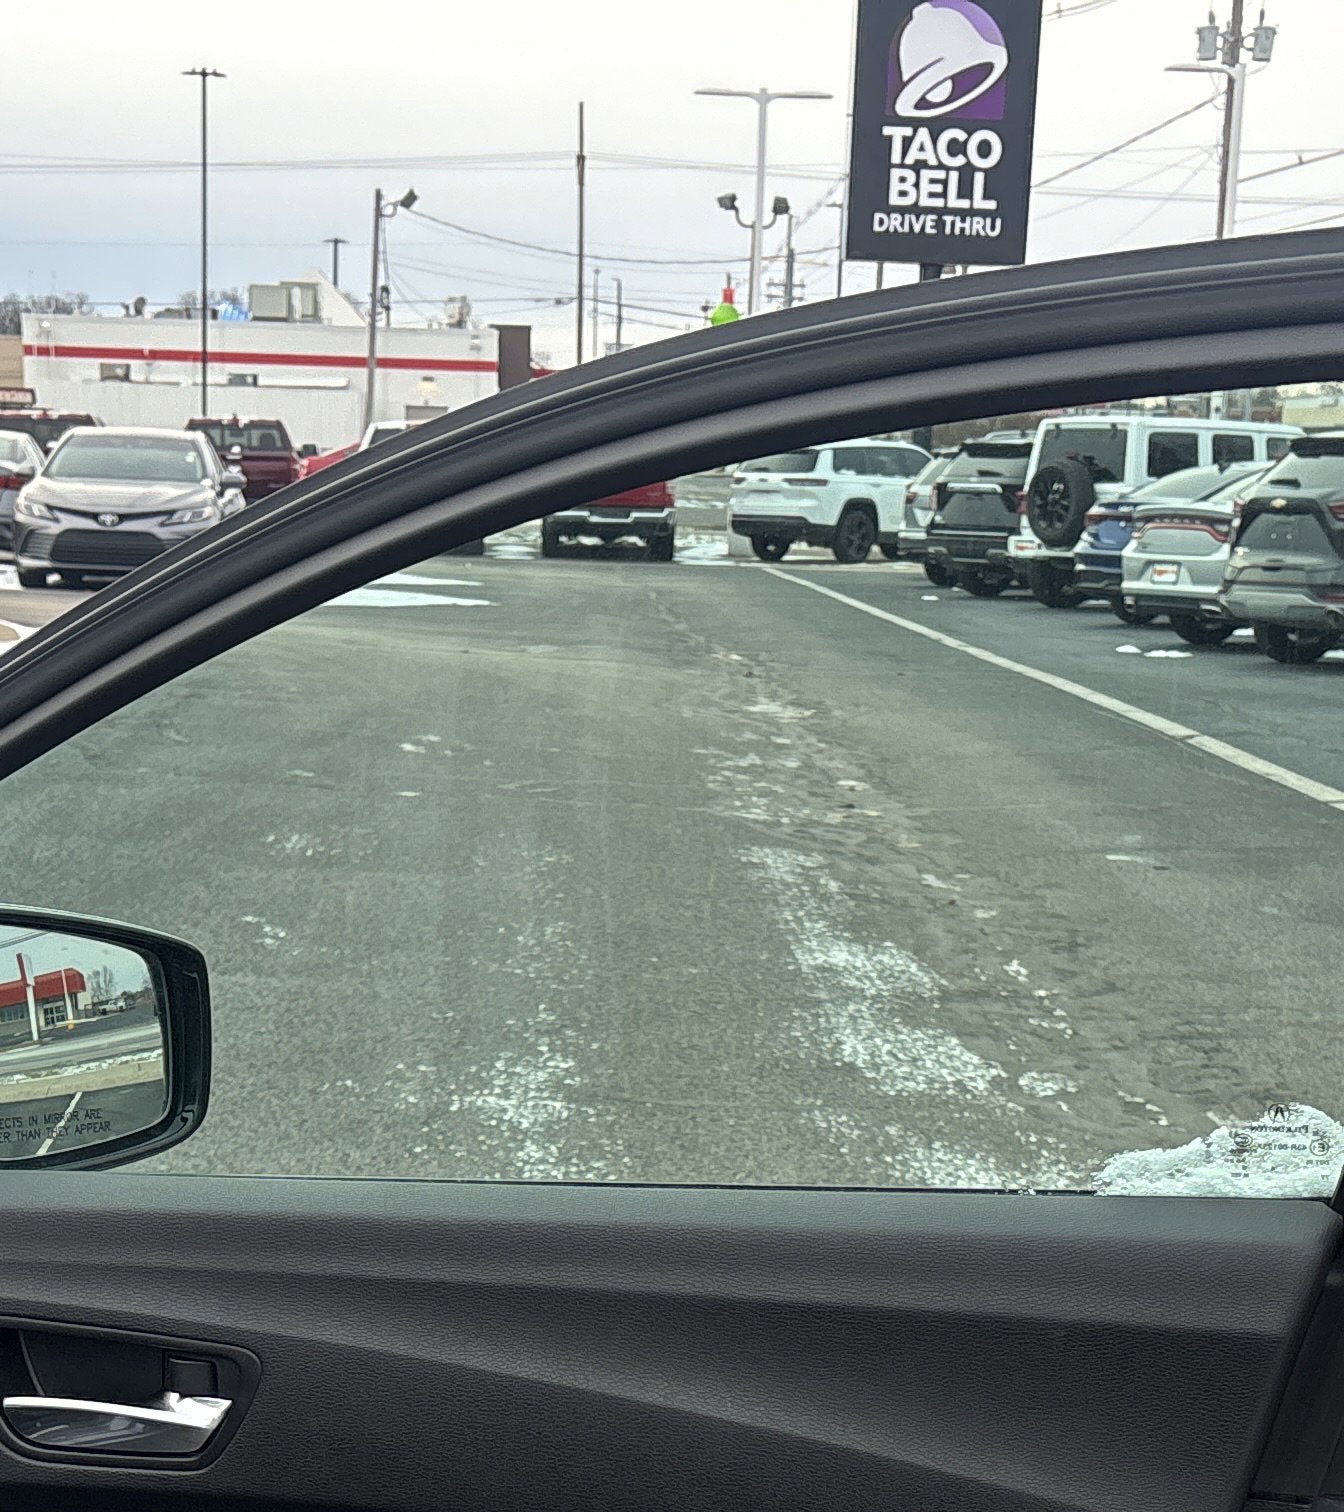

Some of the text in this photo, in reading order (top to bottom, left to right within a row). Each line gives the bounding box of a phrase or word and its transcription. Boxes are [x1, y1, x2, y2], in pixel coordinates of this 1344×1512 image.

[882, 126, 1003, 168] TACO
[888, 168, 998, 210] BELL
[873, 212, 1002, 237] DRIVE THRU
[29, 1115, 38, 1126] IN
[44, 1110, 79, 1124] MIRROR
[84, 1108, 103, 1120] ARE
[16, 1129, 41, 1142] THAN
[47, 1126, 69, 1139] THEY
[74, 1121, 112, 1135] APPEAR
